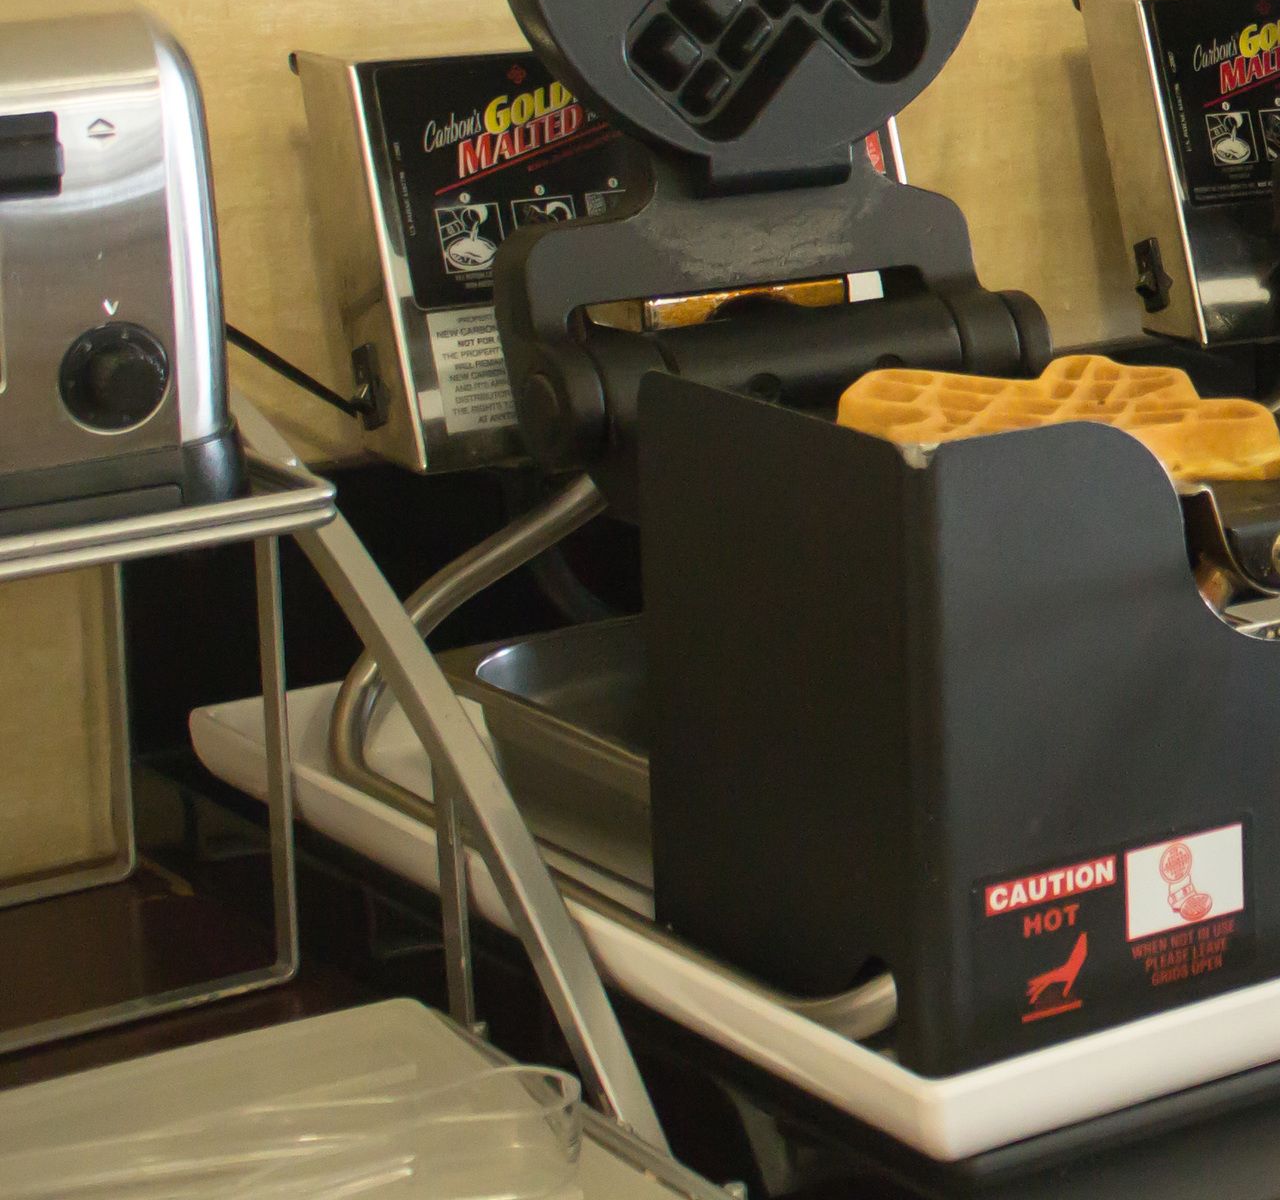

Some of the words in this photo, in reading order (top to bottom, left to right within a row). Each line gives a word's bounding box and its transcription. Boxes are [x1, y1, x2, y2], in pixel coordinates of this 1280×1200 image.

[1193, 35, 1238, 72] Carbon's
[424, 108, 482, 153] Carbon's
[458, 103, 584, 179] MALTED
[989, 859, 1115, 912] CAUTION
[1023, 903, 1080, 938] HOT
[1145, 946, 1187, 974] PLEASE
[1191, 953, 1222, 976] OPEN
